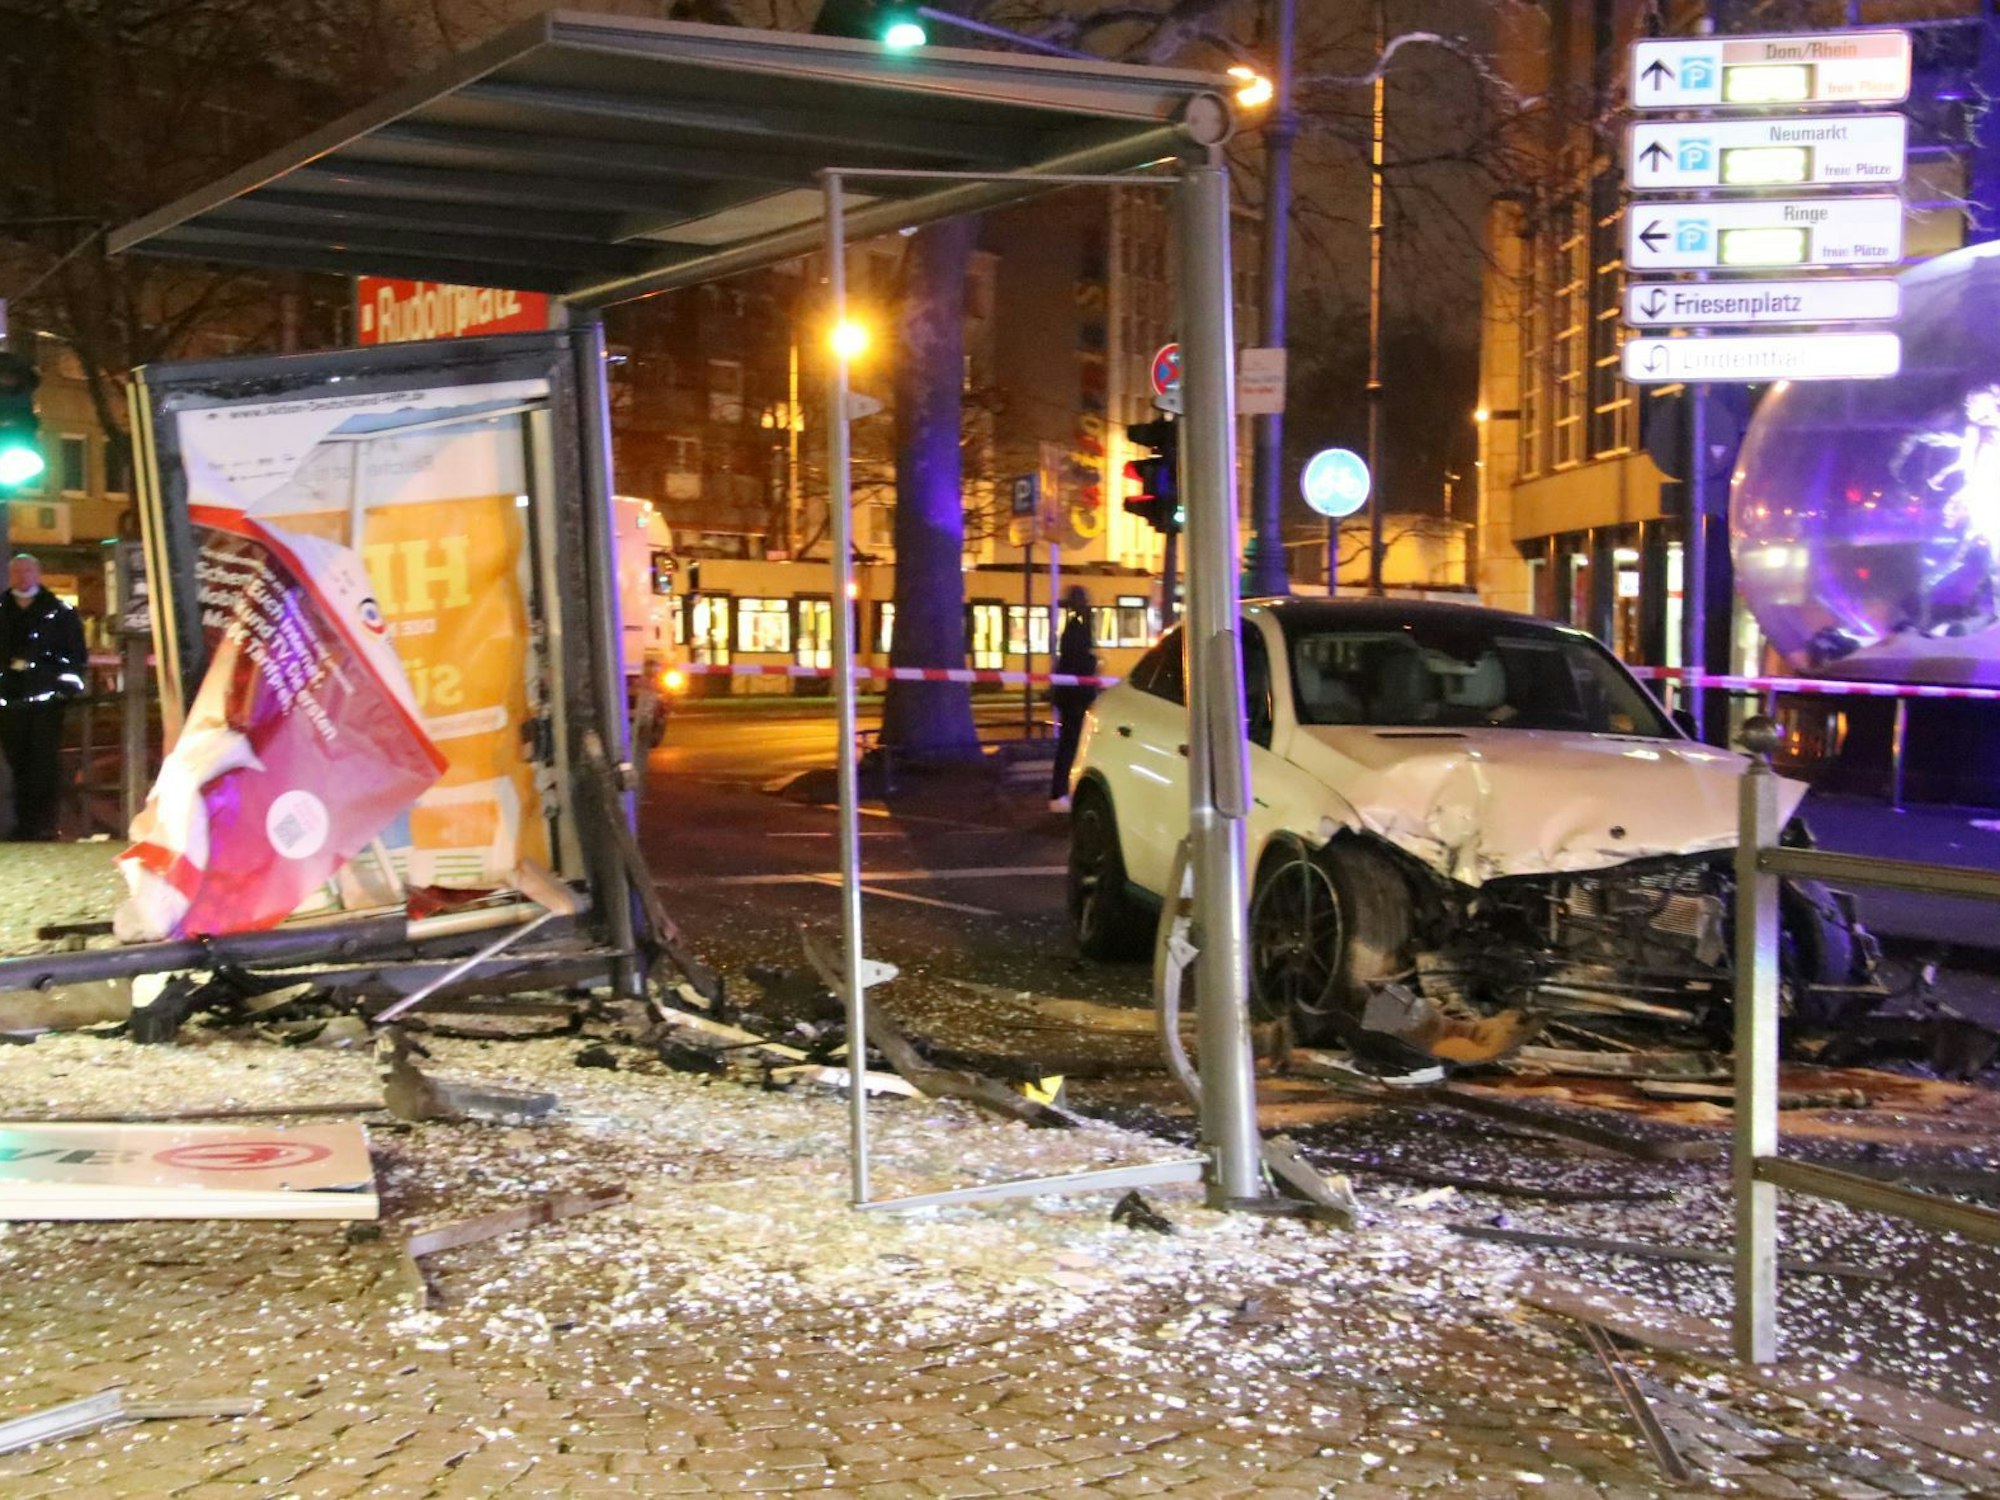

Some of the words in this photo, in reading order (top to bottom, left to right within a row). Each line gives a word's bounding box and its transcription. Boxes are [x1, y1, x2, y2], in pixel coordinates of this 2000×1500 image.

[1766, 42, 1858, 60] Dom/Rhein
[1769, 124, 1848, 141] Neumarkt
[1784, 205, 1829, 224] Ringe
[1674, 291, 1802, 318] Friesenplatz
